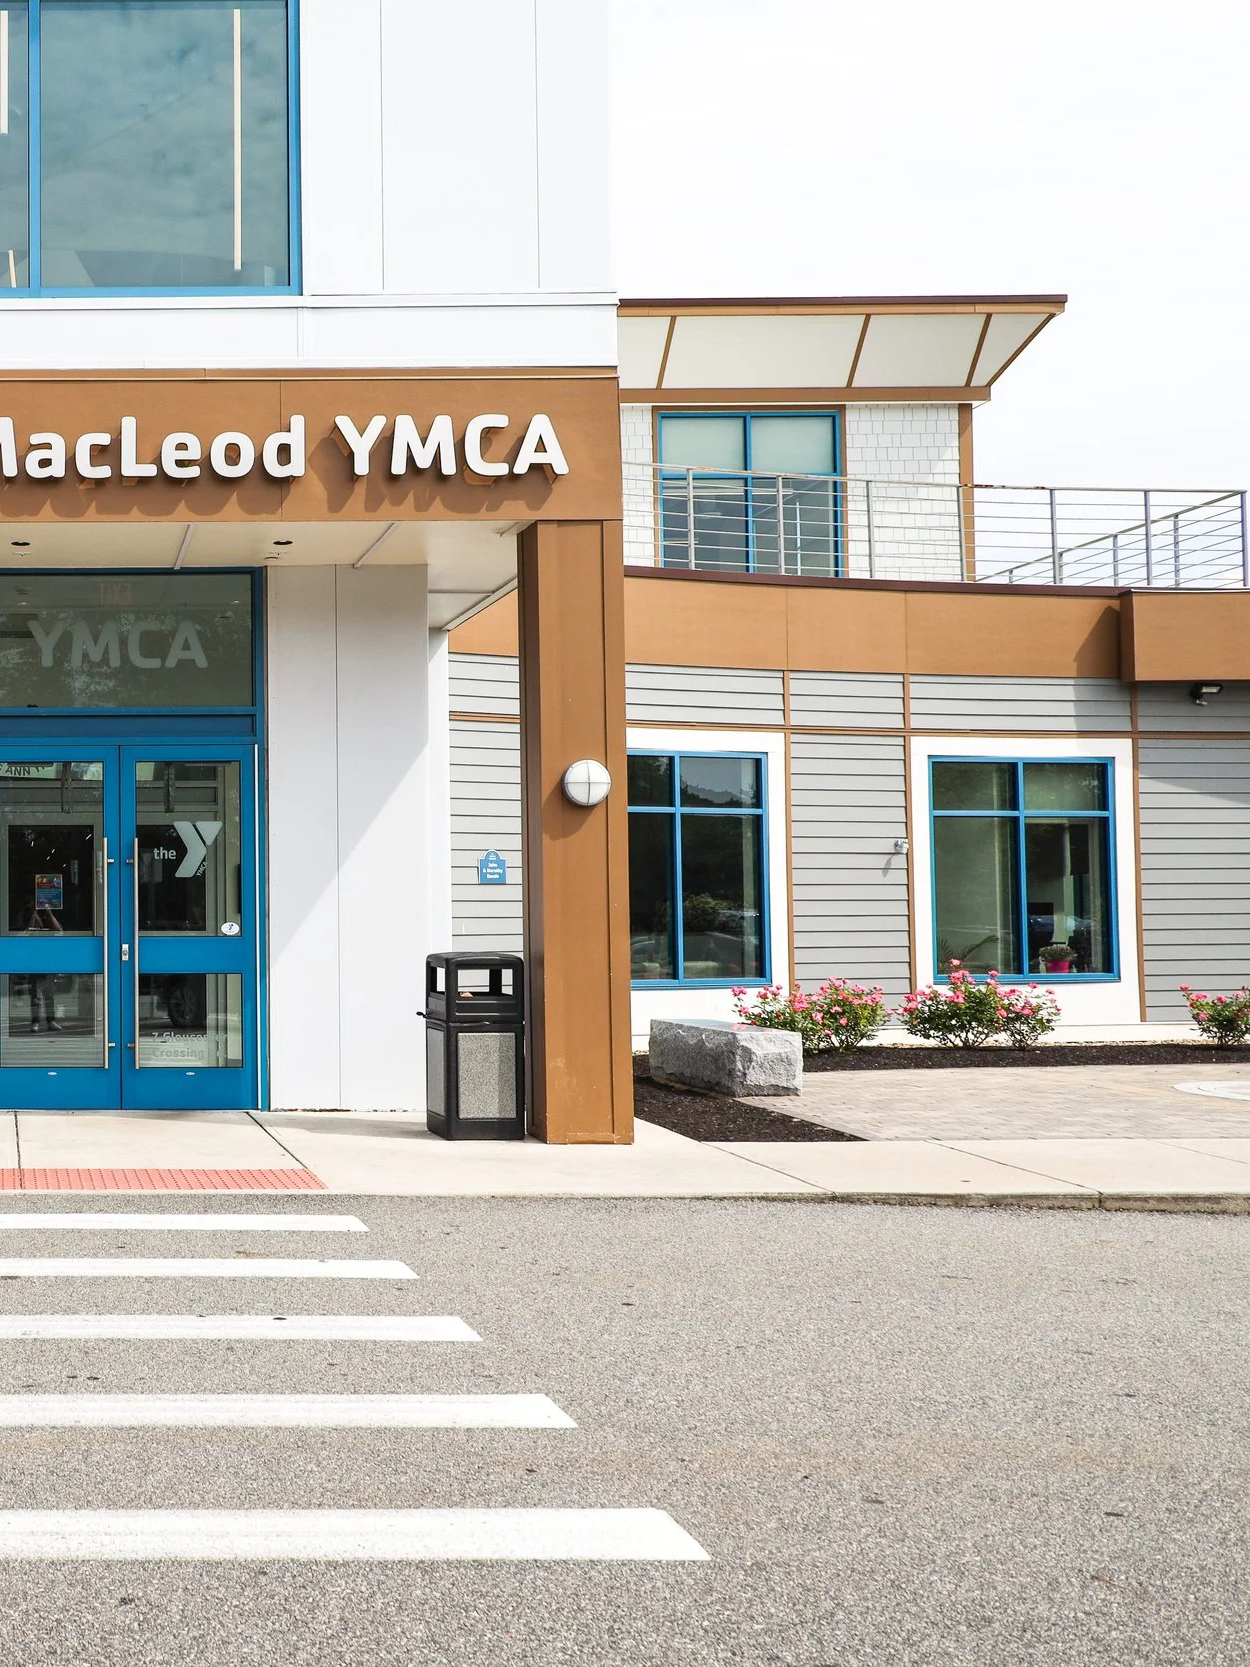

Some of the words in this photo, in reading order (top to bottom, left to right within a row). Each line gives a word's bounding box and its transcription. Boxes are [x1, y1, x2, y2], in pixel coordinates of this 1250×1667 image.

[334, 413, 570, 477] YMCA
[27, 620, 209, 669] YMCA
[5, 766, 31, 776] ANN
[153, 846, 177, 860] the
[196, 861, 208, 877] YMCA
[162, 1031, 228, 1042] Glouceser
[152, 1047, 205, 1060] Crossing
